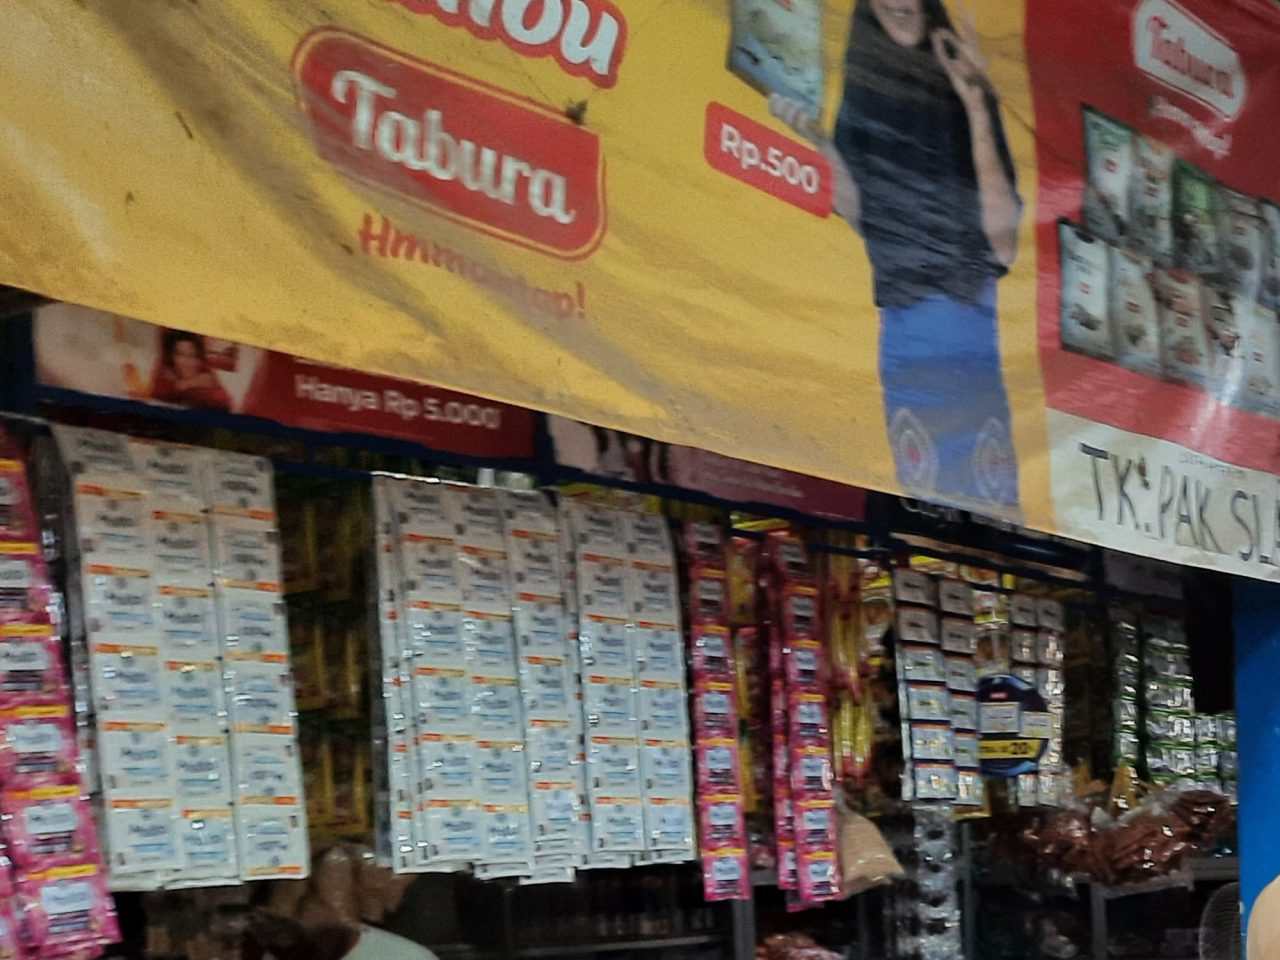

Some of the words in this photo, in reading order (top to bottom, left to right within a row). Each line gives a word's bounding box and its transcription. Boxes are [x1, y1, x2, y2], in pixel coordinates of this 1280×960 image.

[331, 69, 576, 224] Tabura
[720, 121, 820, 195] Rp.500
[295, 373, 378, 412] Hanya
[383, 389, 421, 420] Rp
[423, 398, 501, 429] 5.000
